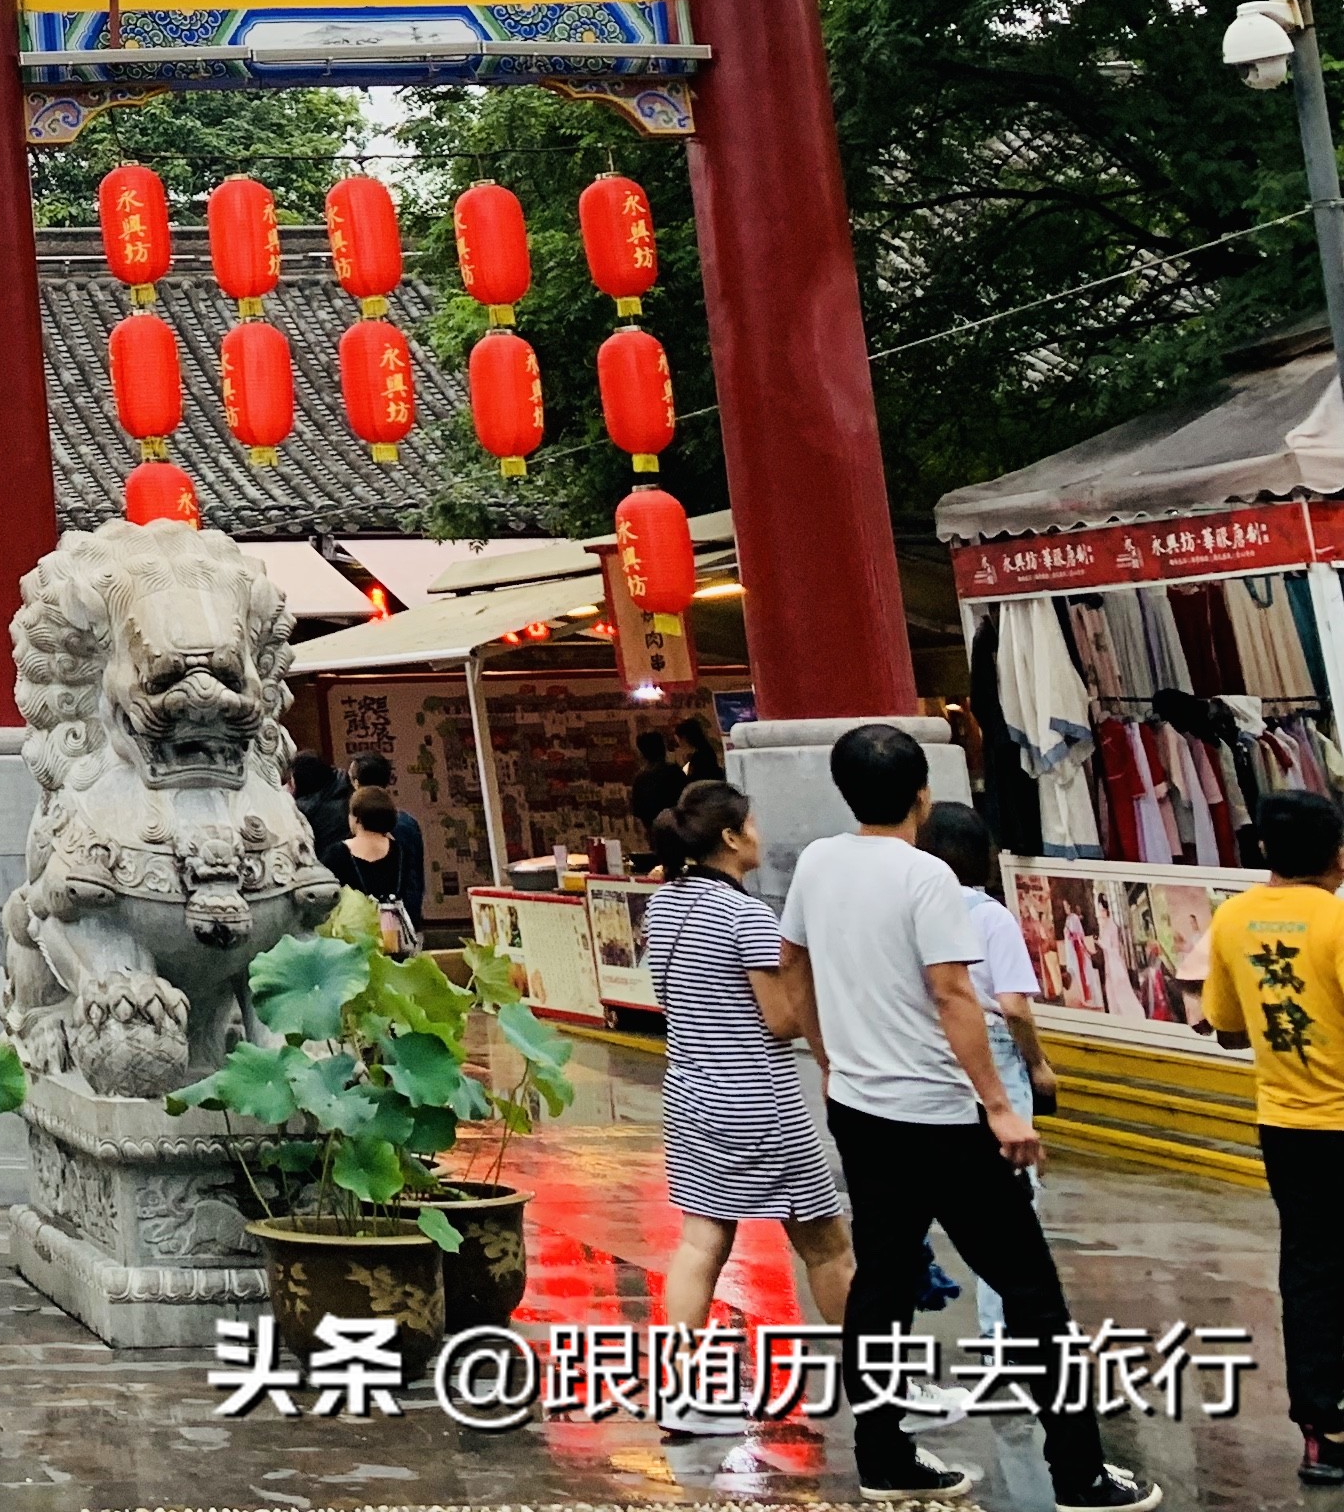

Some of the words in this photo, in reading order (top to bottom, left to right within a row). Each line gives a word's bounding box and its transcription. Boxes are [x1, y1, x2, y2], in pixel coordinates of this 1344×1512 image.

[116, 186, 152, 265] 永興坊
[622, 190, 654, 270] 永興坊
[380, 342, 412, 424] 永興坊
[616, 516, 649, 598] 永興坊
